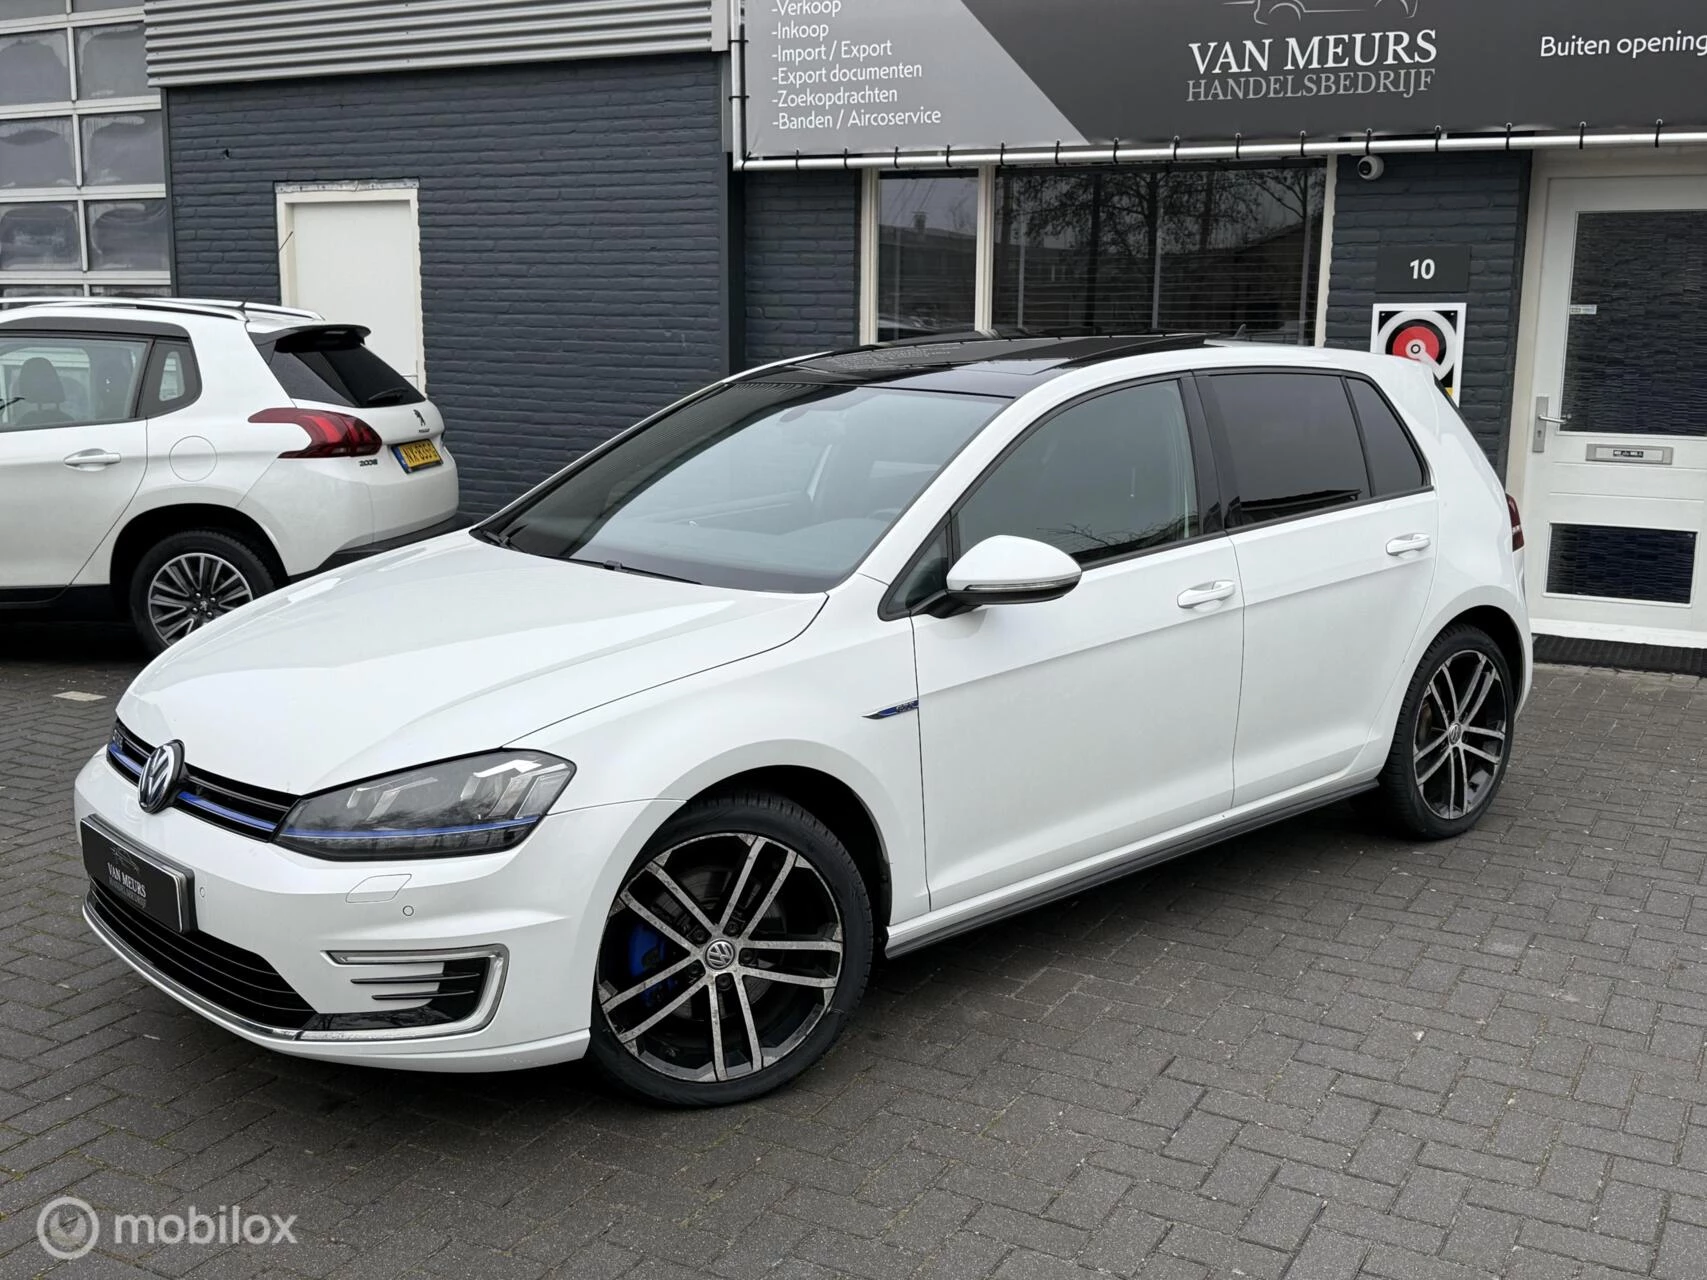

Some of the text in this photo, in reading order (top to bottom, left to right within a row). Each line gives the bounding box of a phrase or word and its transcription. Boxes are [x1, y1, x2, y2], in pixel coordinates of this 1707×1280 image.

[771, 20, 829, 41] -Inkoop
[771, 44, 826, 66] -Import
[841, 40, 893, 62] Export
[1187, 29, 1438, 74] VAN MEURS
[1540, 35, 1610, 57] Buiten
[772, 63, 922, 88] -Export documenten
[1186, 68, 1436, 102] HANDELSBEDRIJF
[772, 110, 833, 130] -Banden
[848, 106, 942, 127] Aircoservice
[1409, 258, 1436, 280] 10
